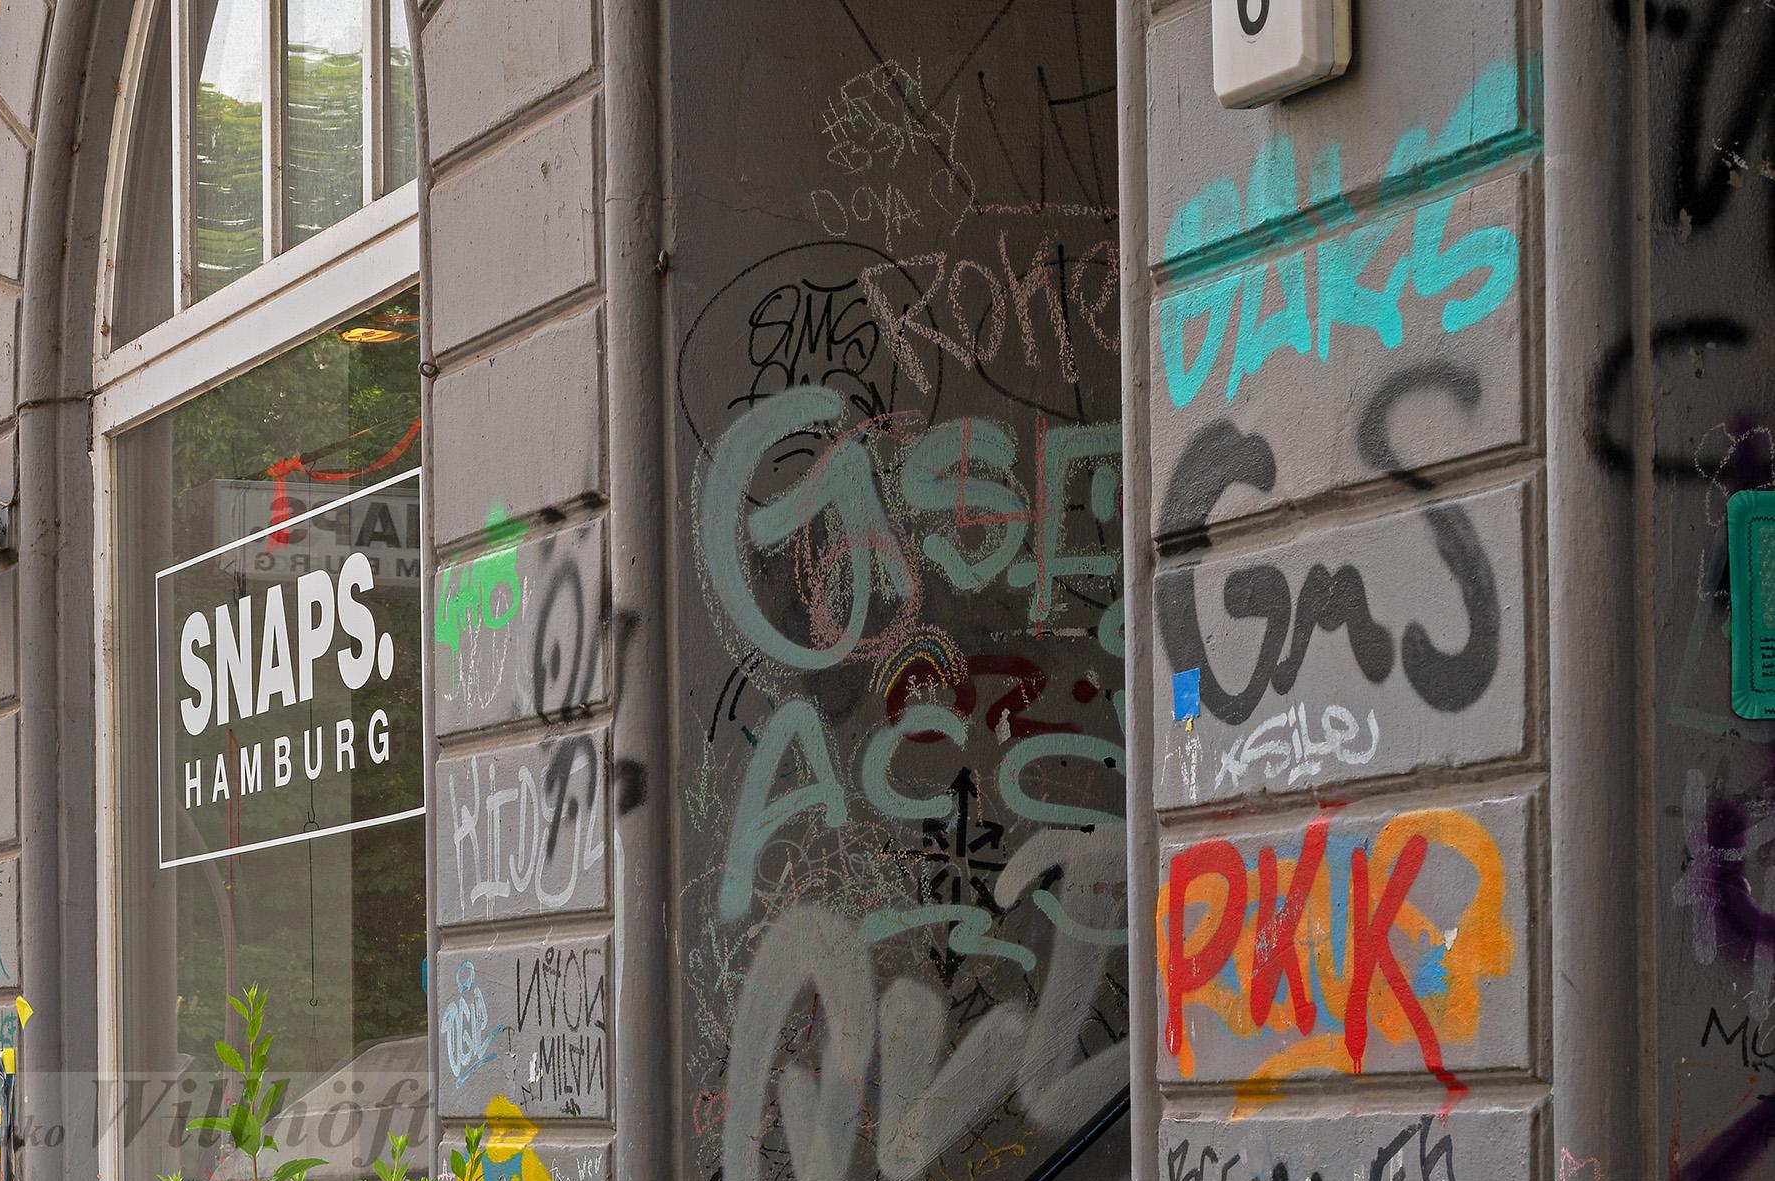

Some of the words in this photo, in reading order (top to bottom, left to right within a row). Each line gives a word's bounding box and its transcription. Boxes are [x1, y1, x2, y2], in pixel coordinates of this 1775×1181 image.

[180, 551, 394, 736] SNAPS.
[185, 708, 390, 809] HAMBURG
[1165, 801, 1469, 1108] PKK
